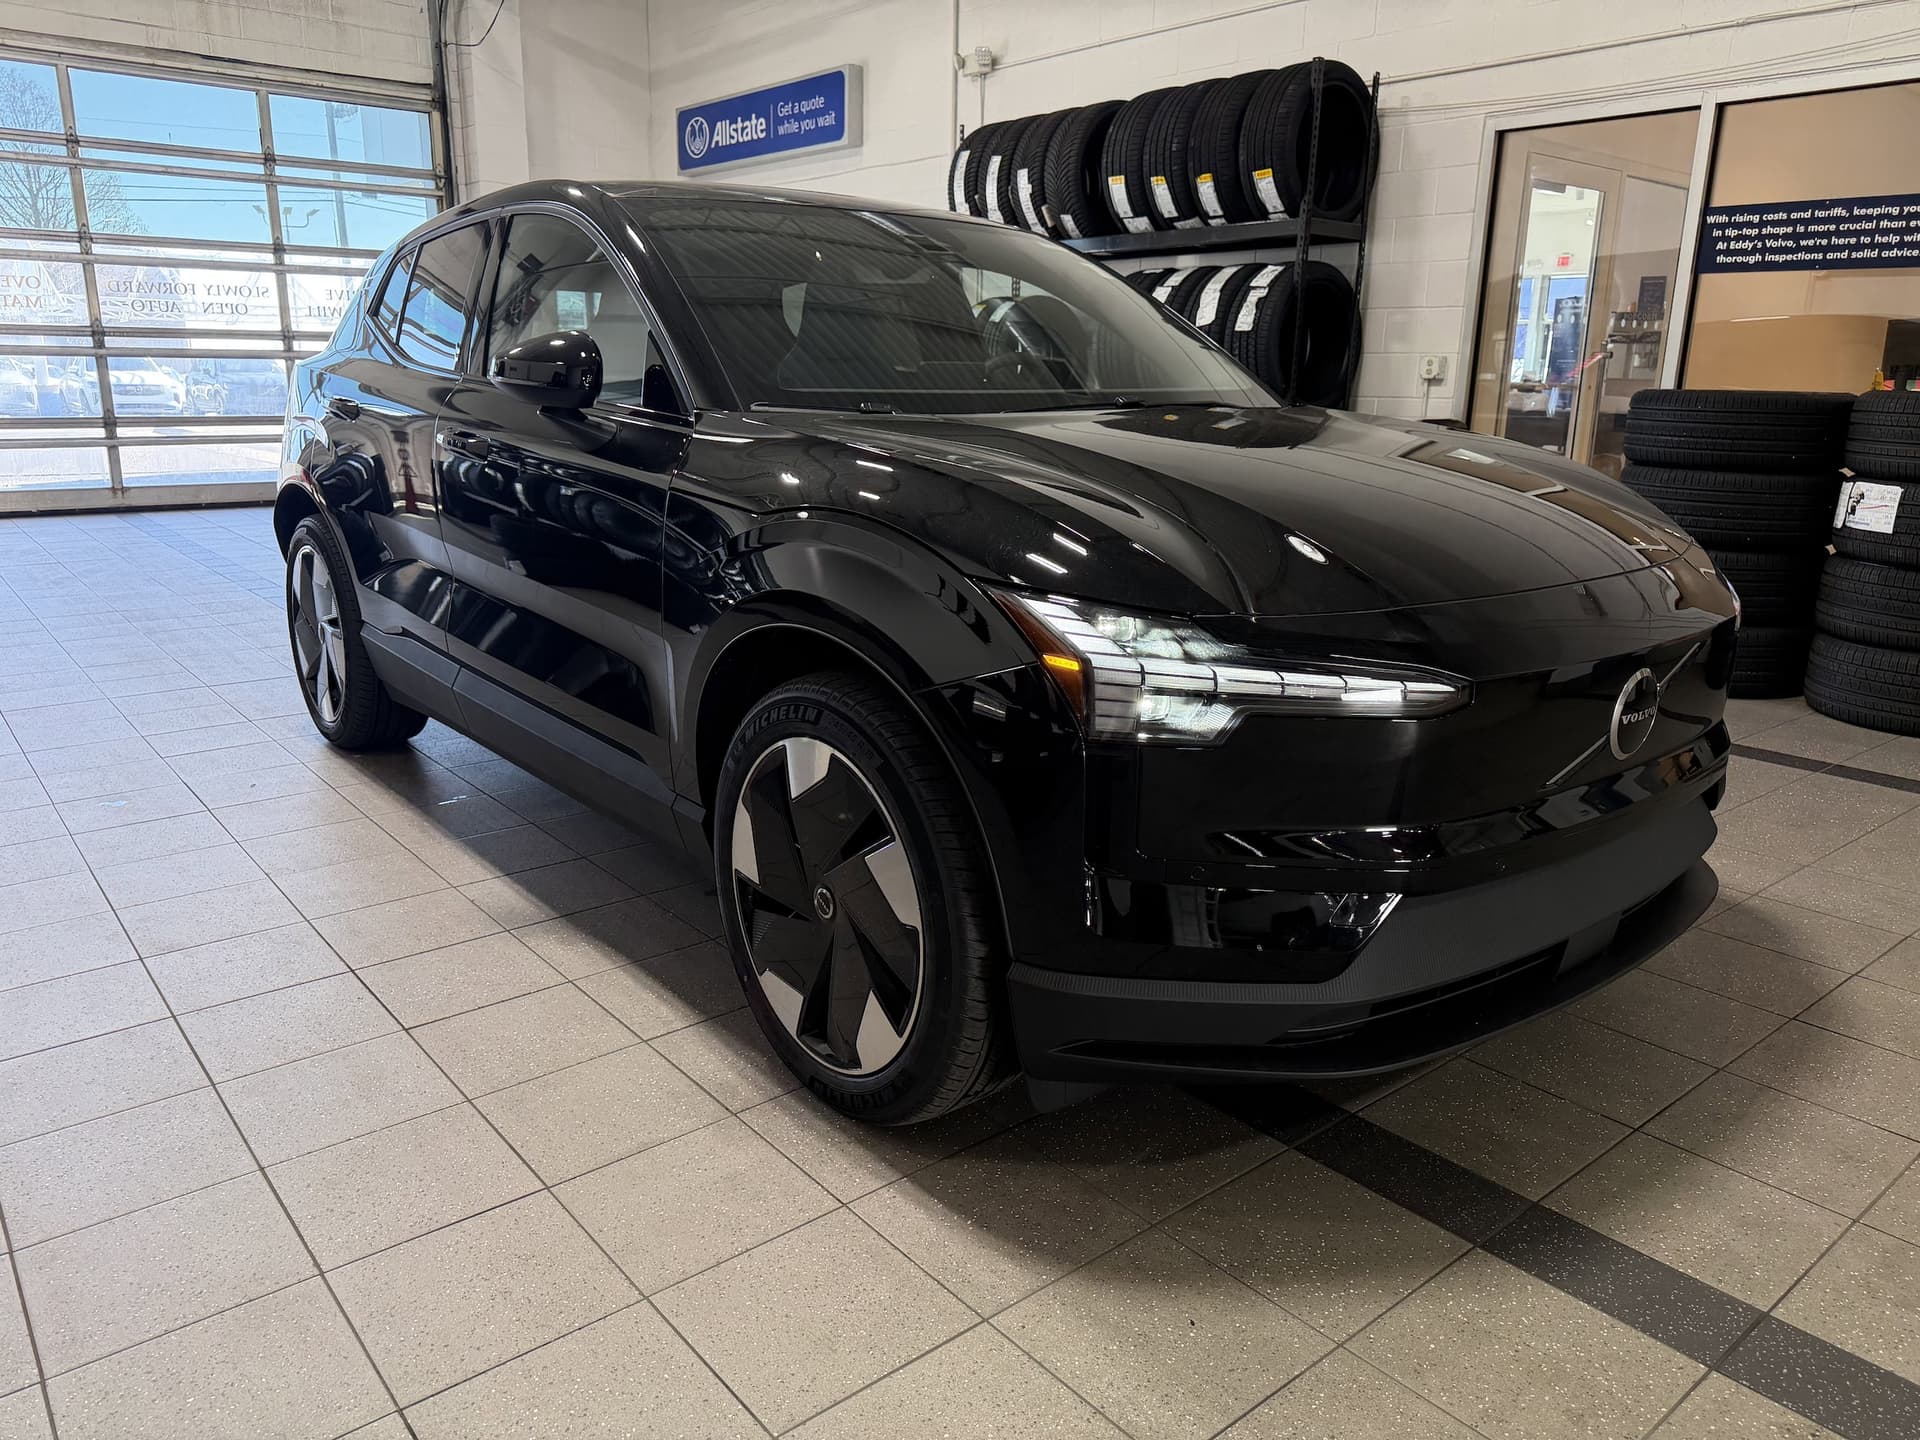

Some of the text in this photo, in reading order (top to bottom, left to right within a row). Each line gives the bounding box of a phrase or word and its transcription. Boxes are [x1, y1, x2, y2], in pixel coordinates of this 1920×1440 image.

[778, 95, 825, 117] Get a quote
[711, 113, 766, 148] Allstate
[777, 112, 836, 136] while you wait
[1706, 214, 1729, 224] With
[1731, 213, 1760, 223] rising
[1763, 212, 1787, 221] costs
[1790, 209, 1812, 219] and
[1814, 207, 1850, 218] tariffs,
[1853, 205, 1900, 216] keeping
[1712, 228, 1722, 237] in
[1725, 227, 1759, 238] tip-top
[1761, 225, 1793, 235] shape
[1796, 224, 1805, 232] is
[1808, 224, 1836, 232] more
[1839, 220, 1876, 230] crucial
[1879, 219, 1906, 229] than
[1715, 241, 1727, 250] At
[1729, 240, 1762, 251] Eddy's
[1765, 239, 1796, 248] Volvo,
[1799, 237, 1828, 246] we're
[1831, 236, 1857, 245] here
[1860, 236, 1871, 244] to
[1874, 233, 1900, 245] help
[1716, 253, 1762, 264] thorough
[1765, 251, 1823, 263] inspections
[1826, 250, 1848, 260] and
[1851, 249, 1878, 258] solid
[745, 704, 819, 740] MICHELIN
[1622, 706, 1656, 725] VOLVO
